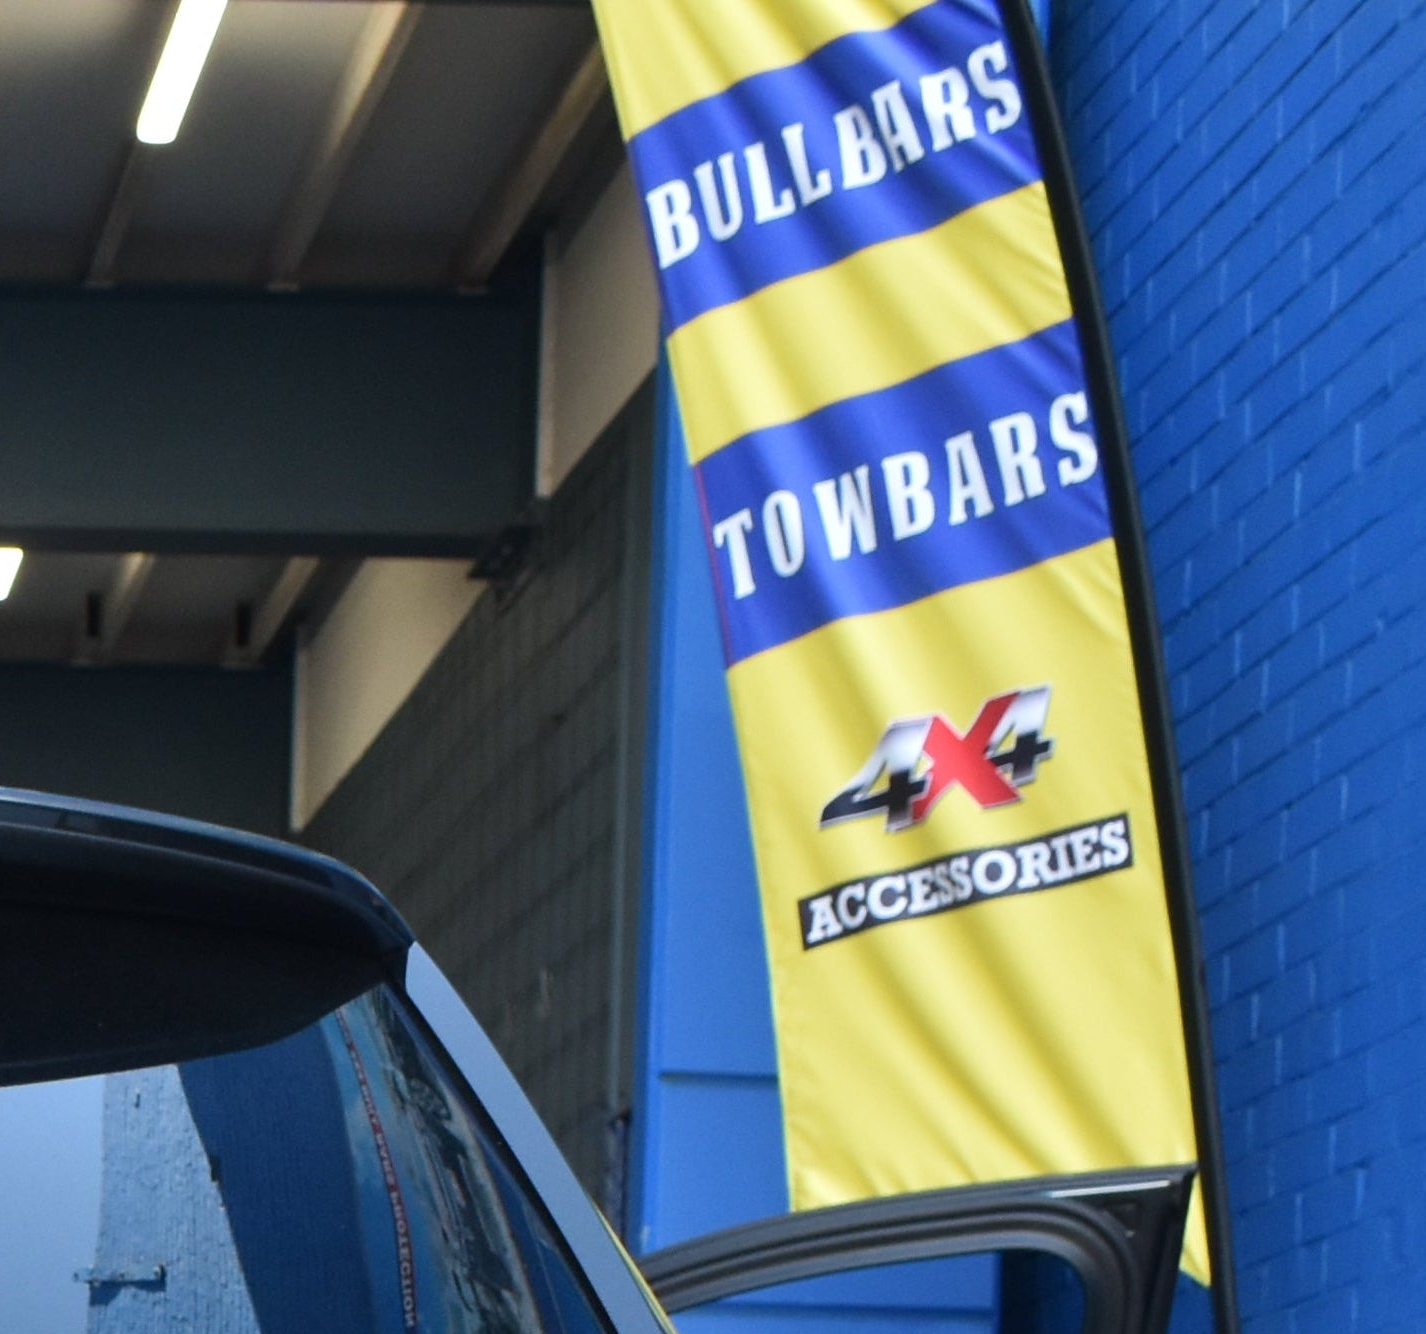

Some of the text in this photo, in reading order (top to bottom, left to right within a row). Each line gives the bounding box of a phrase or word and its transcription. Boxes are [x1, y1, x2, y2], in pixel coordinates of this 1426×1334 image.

[645, 40, 1023, 270] BULLBARS
[713, 391, 1099, 600] TOWBARS
[804, 818, 1130, 944] ACCESSORIES
